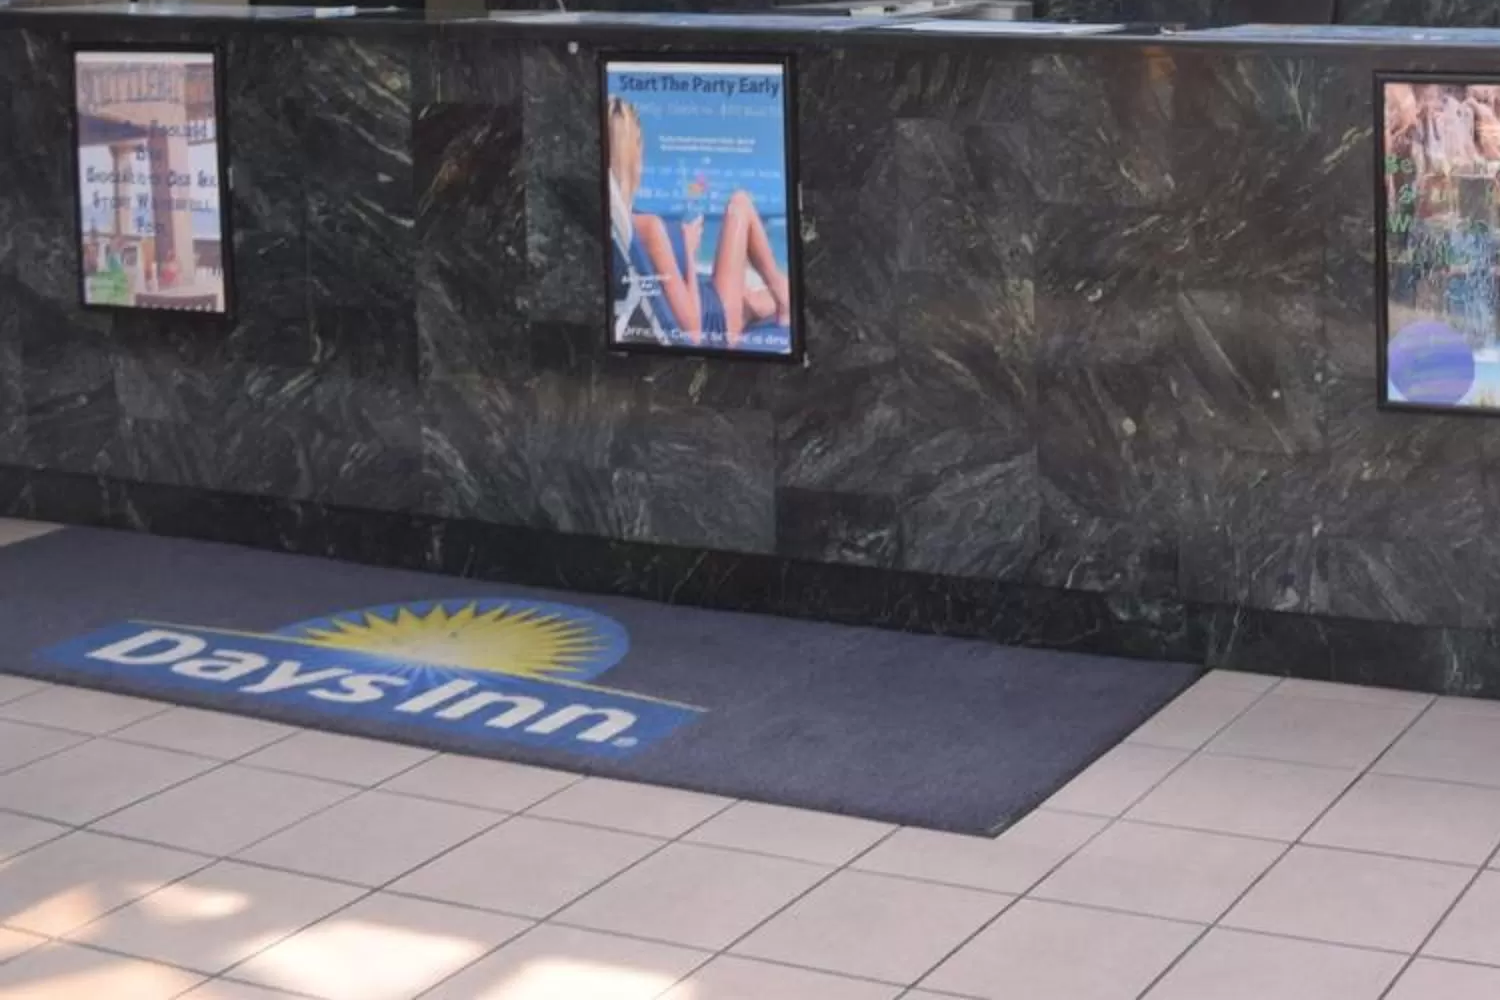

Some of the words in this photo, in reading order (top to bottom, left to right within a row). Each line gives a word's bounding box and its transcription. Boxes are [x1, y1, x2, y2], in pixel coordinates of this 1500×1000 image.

[619, 75, 657, 92] Start
[660, 76, 689, 91] The
[692, 76, 736, 96] Party
[739, 77, 779, 98] Early
[85, 629, 408, 703] Days
